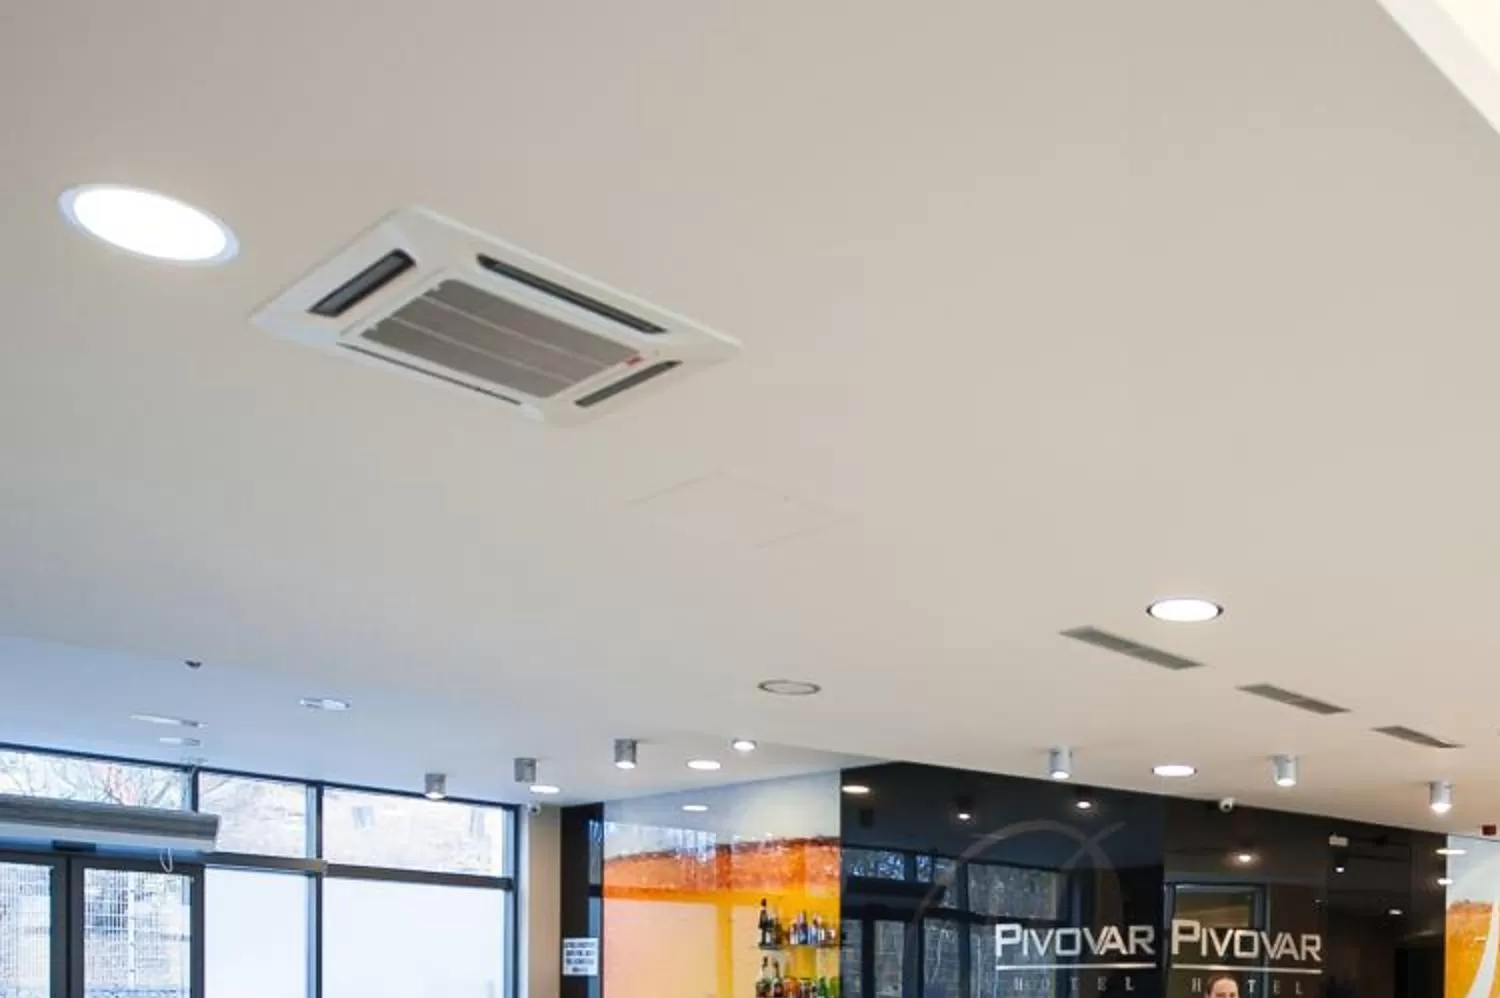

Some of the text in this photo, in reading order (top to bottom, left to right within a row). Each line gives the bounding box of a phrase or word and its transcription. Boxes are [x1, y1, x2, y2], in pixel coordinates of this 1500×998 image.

[995, 922, 1156, 957] PIVOVAR
[1171, 919, 1323, 962] PIVOVAR
[1191, 977, 1303, 995] HTEL
